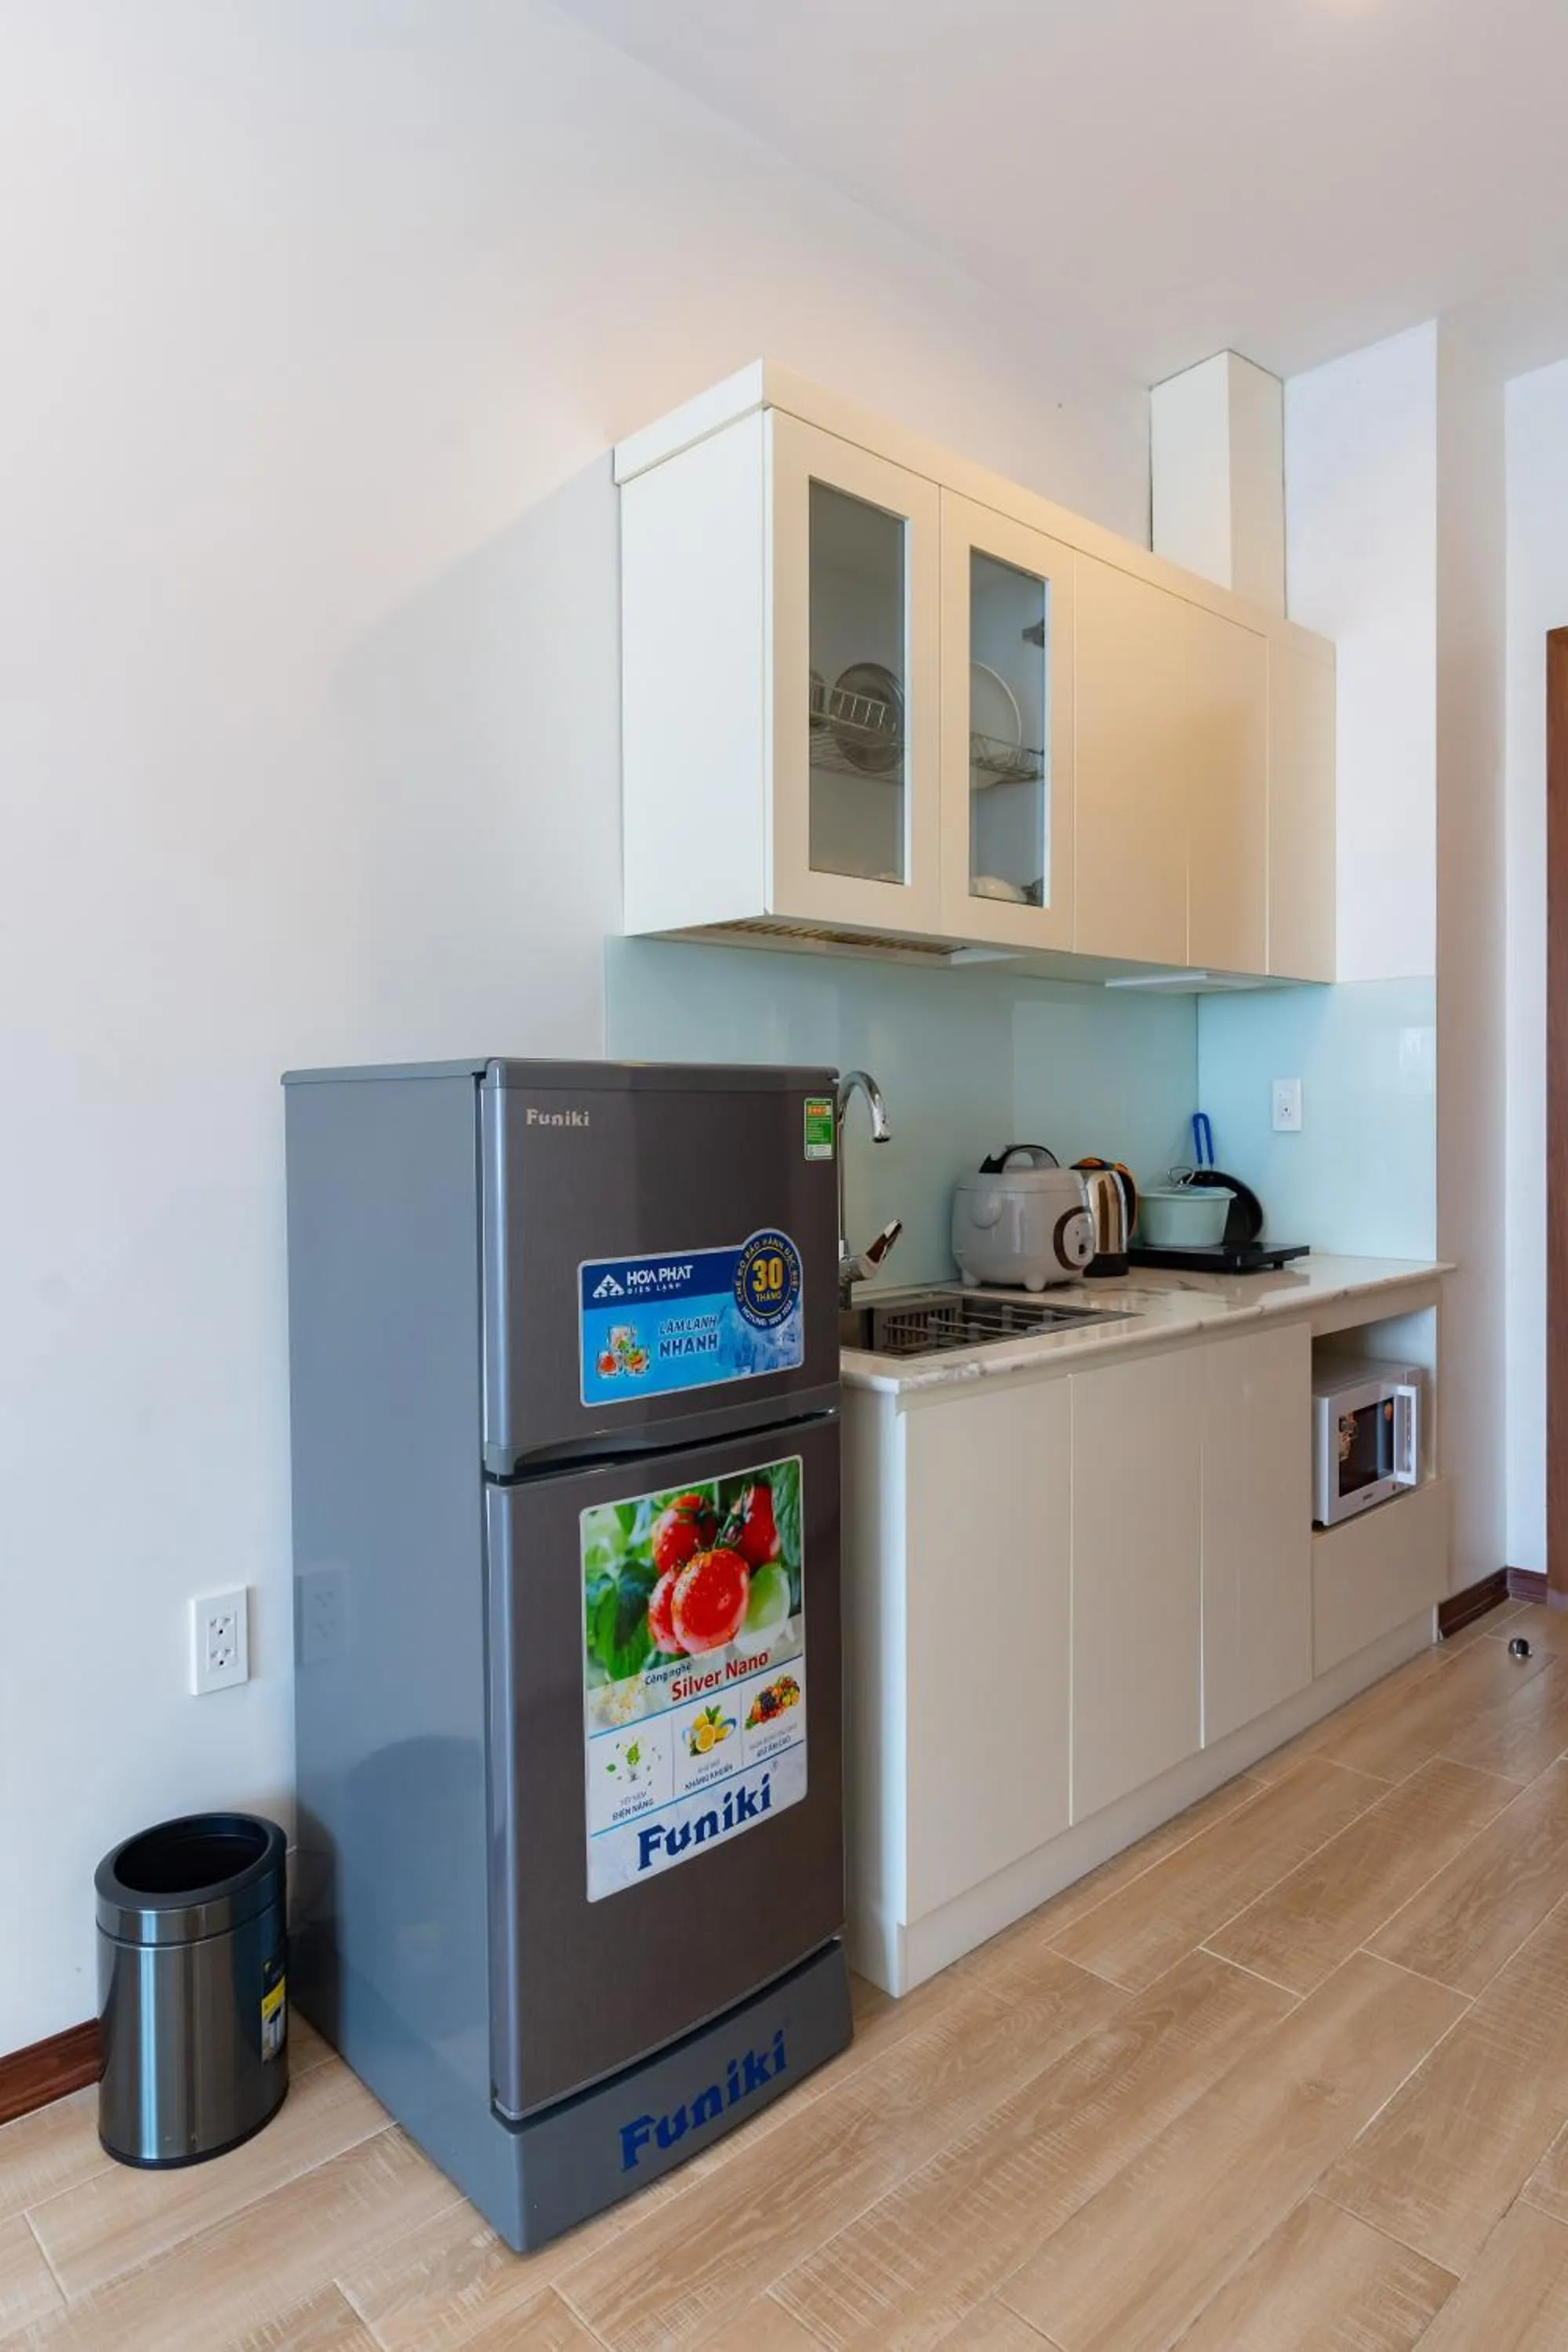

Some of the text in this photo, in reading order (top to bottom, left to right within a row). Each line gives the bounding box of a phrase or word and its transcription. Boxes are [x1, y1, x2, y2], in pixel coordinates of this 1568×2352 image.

[526, 1109, 590, 1127] Funiki
[753, 1257, 783, 1293] 30
[659, 1332, 718, 1359] NHANH
[672, 1651, 768, 1702] Silver Nano
[637, 1773, 771, 1871] Funiki
[619, 2029, 787, 2172] Funiki
